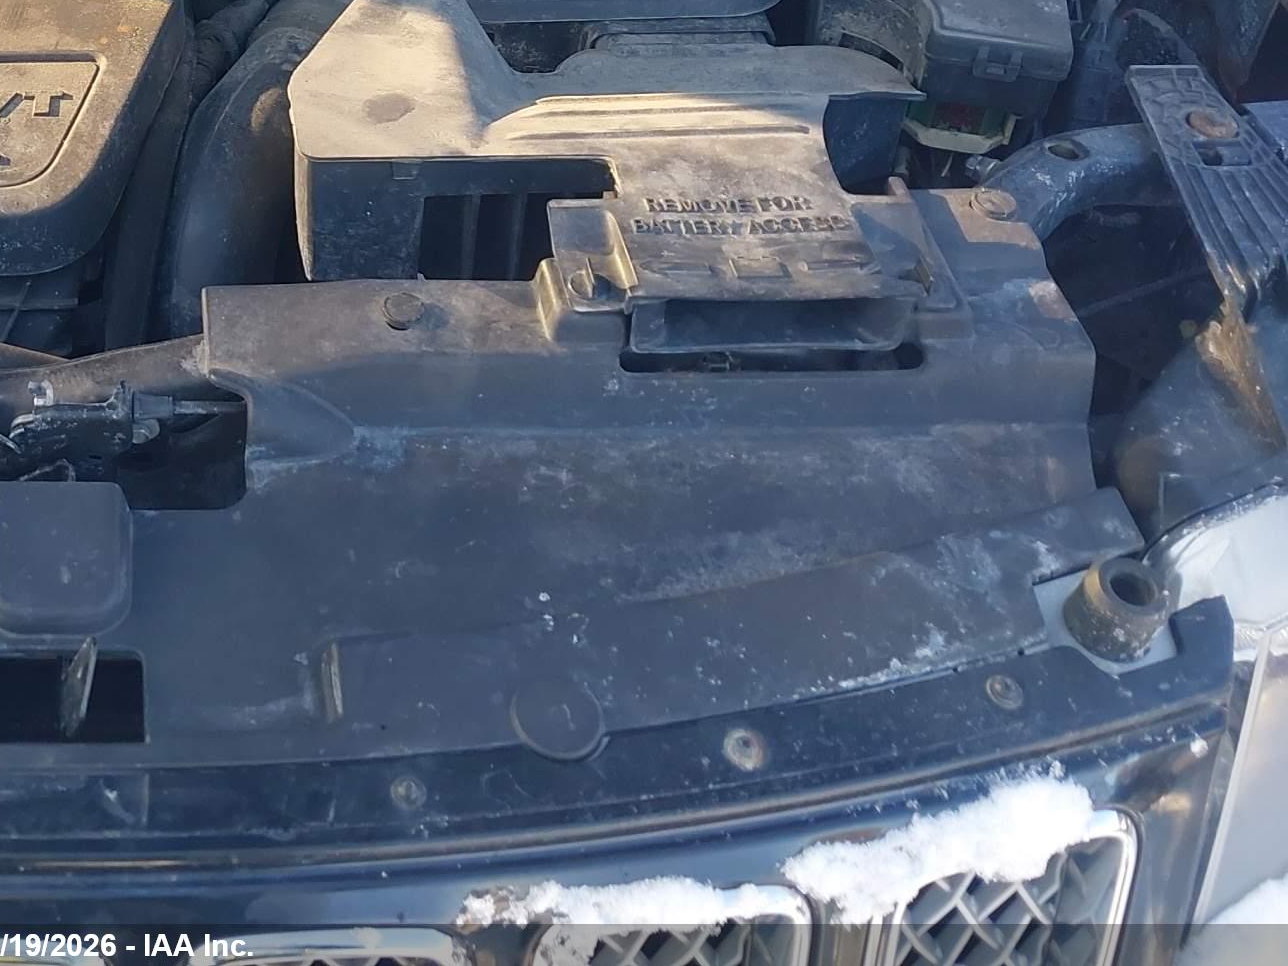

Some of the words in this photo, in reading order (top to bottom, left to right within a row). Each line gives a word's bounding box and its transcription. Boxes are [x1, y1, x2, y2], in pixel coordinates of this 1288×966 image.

[645, 196, 755, 214] REMOVE
[757, 194, 814, 213] FOR
[633, 217, 742, 235] BATTERY
[747, 216, 851, 235] ACCESS
